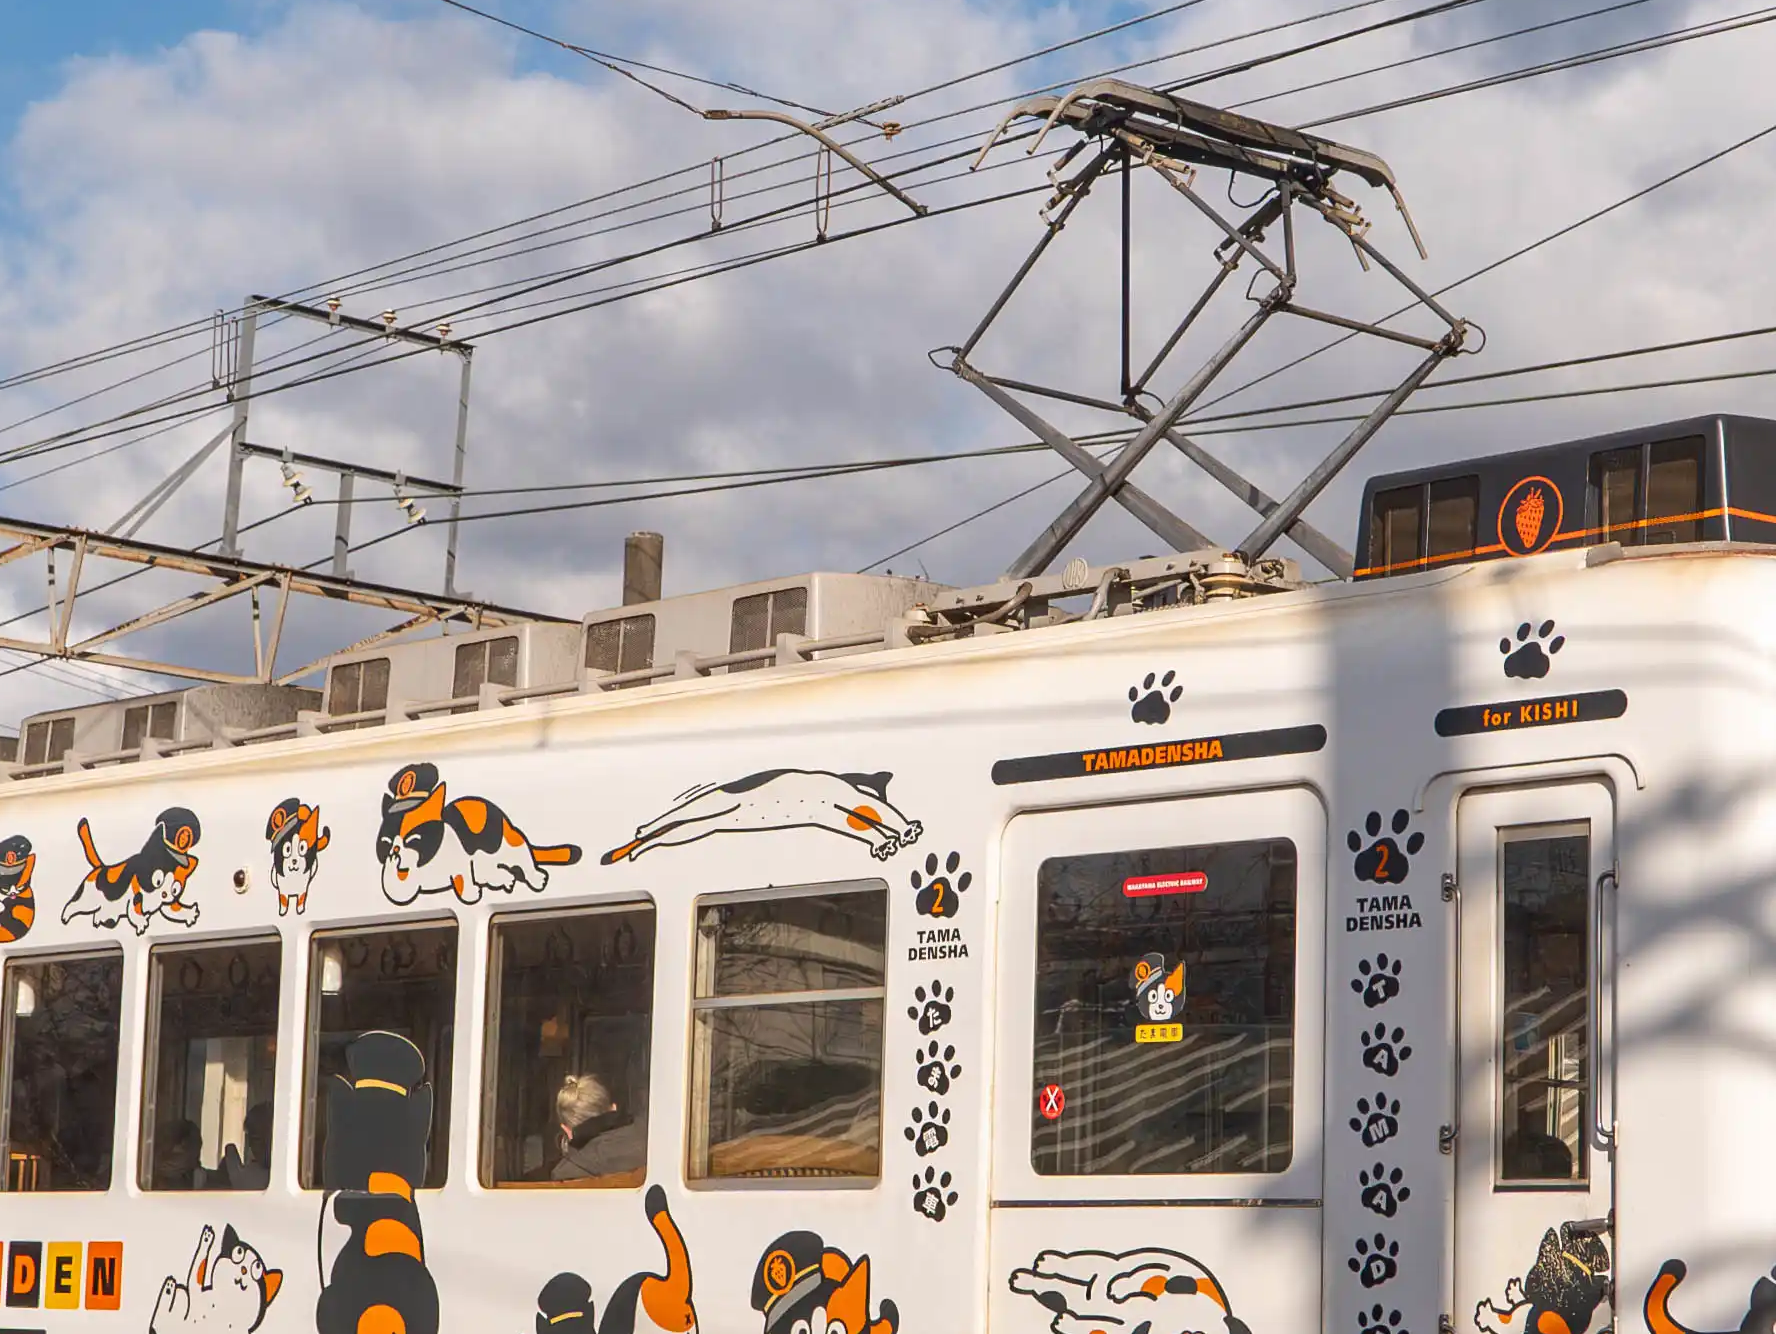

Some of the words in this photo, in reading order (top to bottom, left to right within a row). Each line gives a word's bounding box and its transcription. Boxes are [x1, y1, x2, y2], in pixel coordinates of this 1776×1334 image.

[1483, 709, 1510, 727] for
[1520, 700, 1579, 723] KISHI
[1082, 740, 1223, 772] TAMADENSHA
[1376, 845, 1390, 879] 2
[931, 884, 944, 914] 2
[1356, 896, 1412, 914] TAMA
[1345, 912, 1423, 933] DENSHA
[916, 928, 962, 945] TAMA
[908, 944, 969, 962] DENSHA
[1139, 1026, 1180, 1041] たま電車
